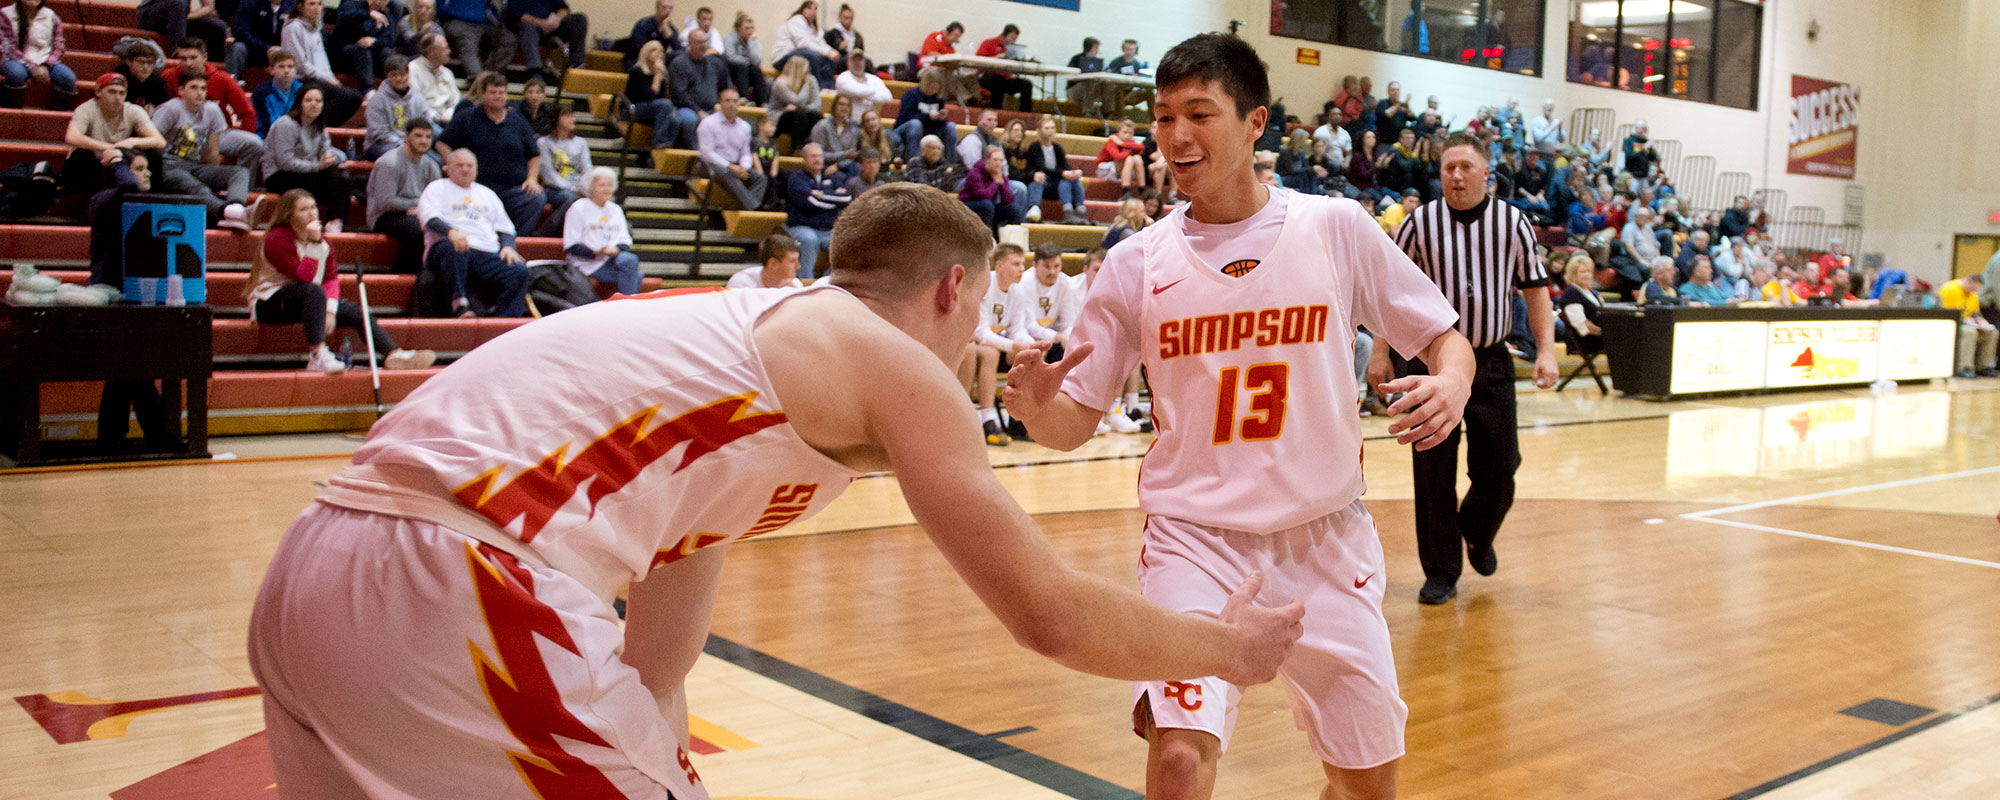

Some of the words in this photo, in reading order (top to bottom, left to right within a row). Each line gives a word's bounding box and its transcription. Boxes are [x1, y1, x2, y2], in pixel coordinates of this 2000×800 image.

[1789, 85, 1860, 144] SUCCESS
[1159, 305, 1329, 360] SIMPSON
[1212, 361, 1290, 446] 13
[1163, 680, 1203, 712] SC
